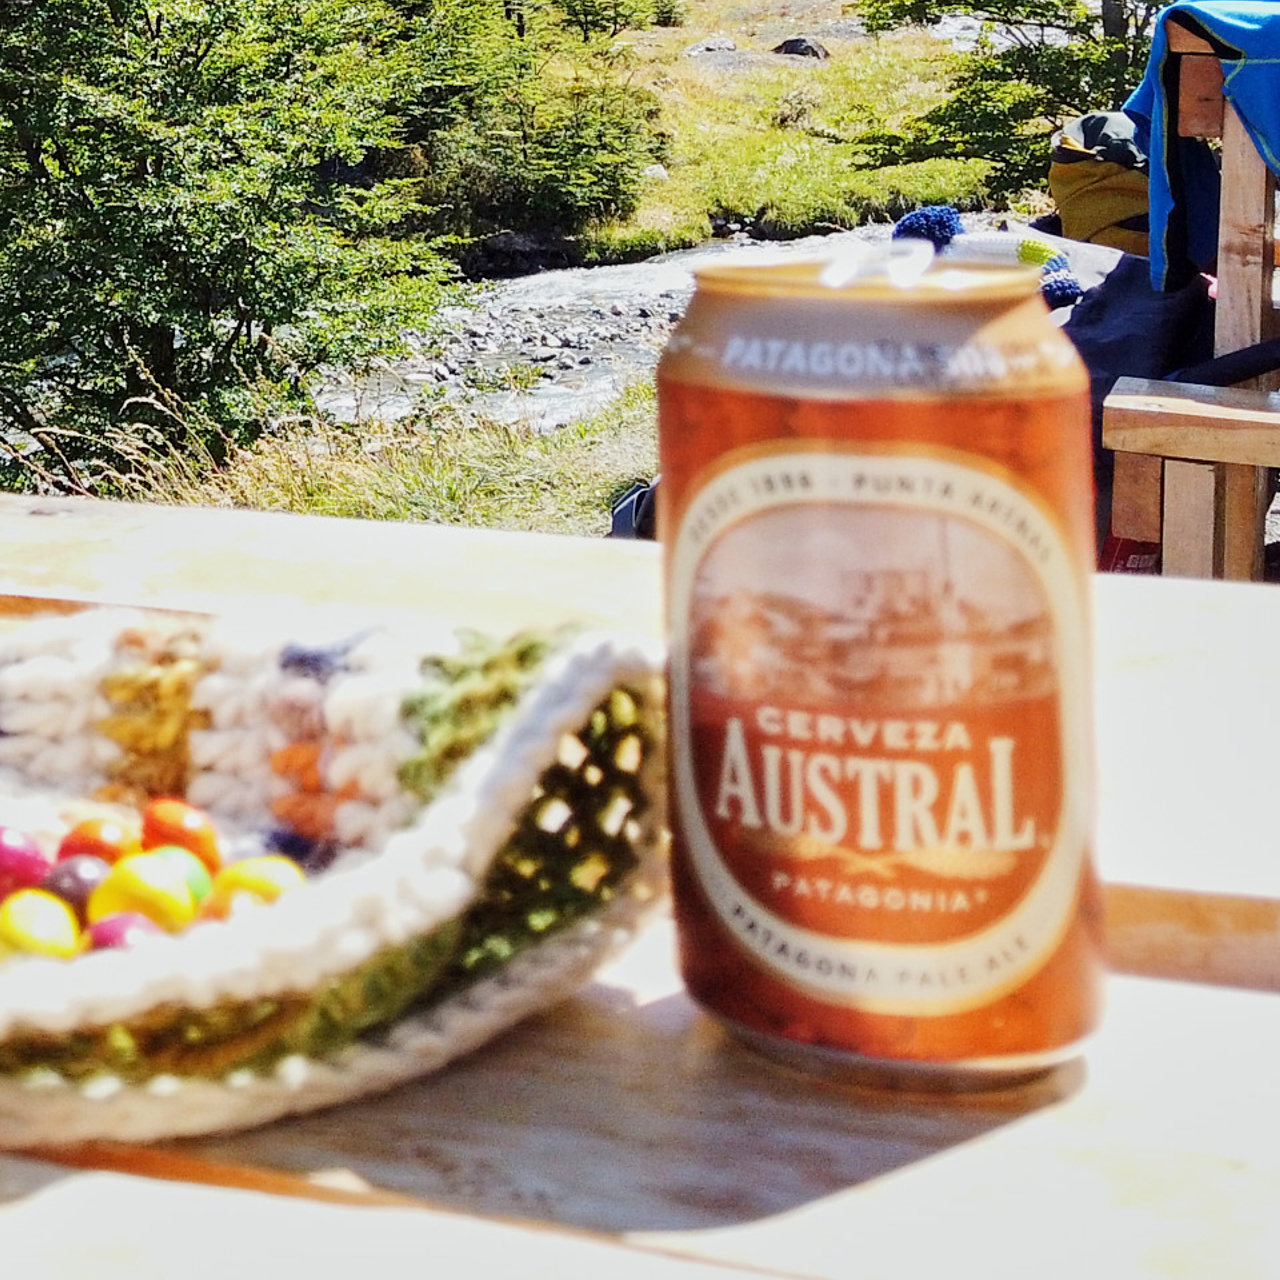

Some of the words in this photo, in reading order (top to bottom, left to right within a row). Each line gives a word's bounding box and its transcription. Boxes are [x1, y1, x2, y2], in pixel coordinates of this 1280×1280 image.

[756, 706, 972, 751] CERVEZA
[716, 717, 1036, 851] AUSTRAL
[772, 872, 970, 913] PATAGONIA
